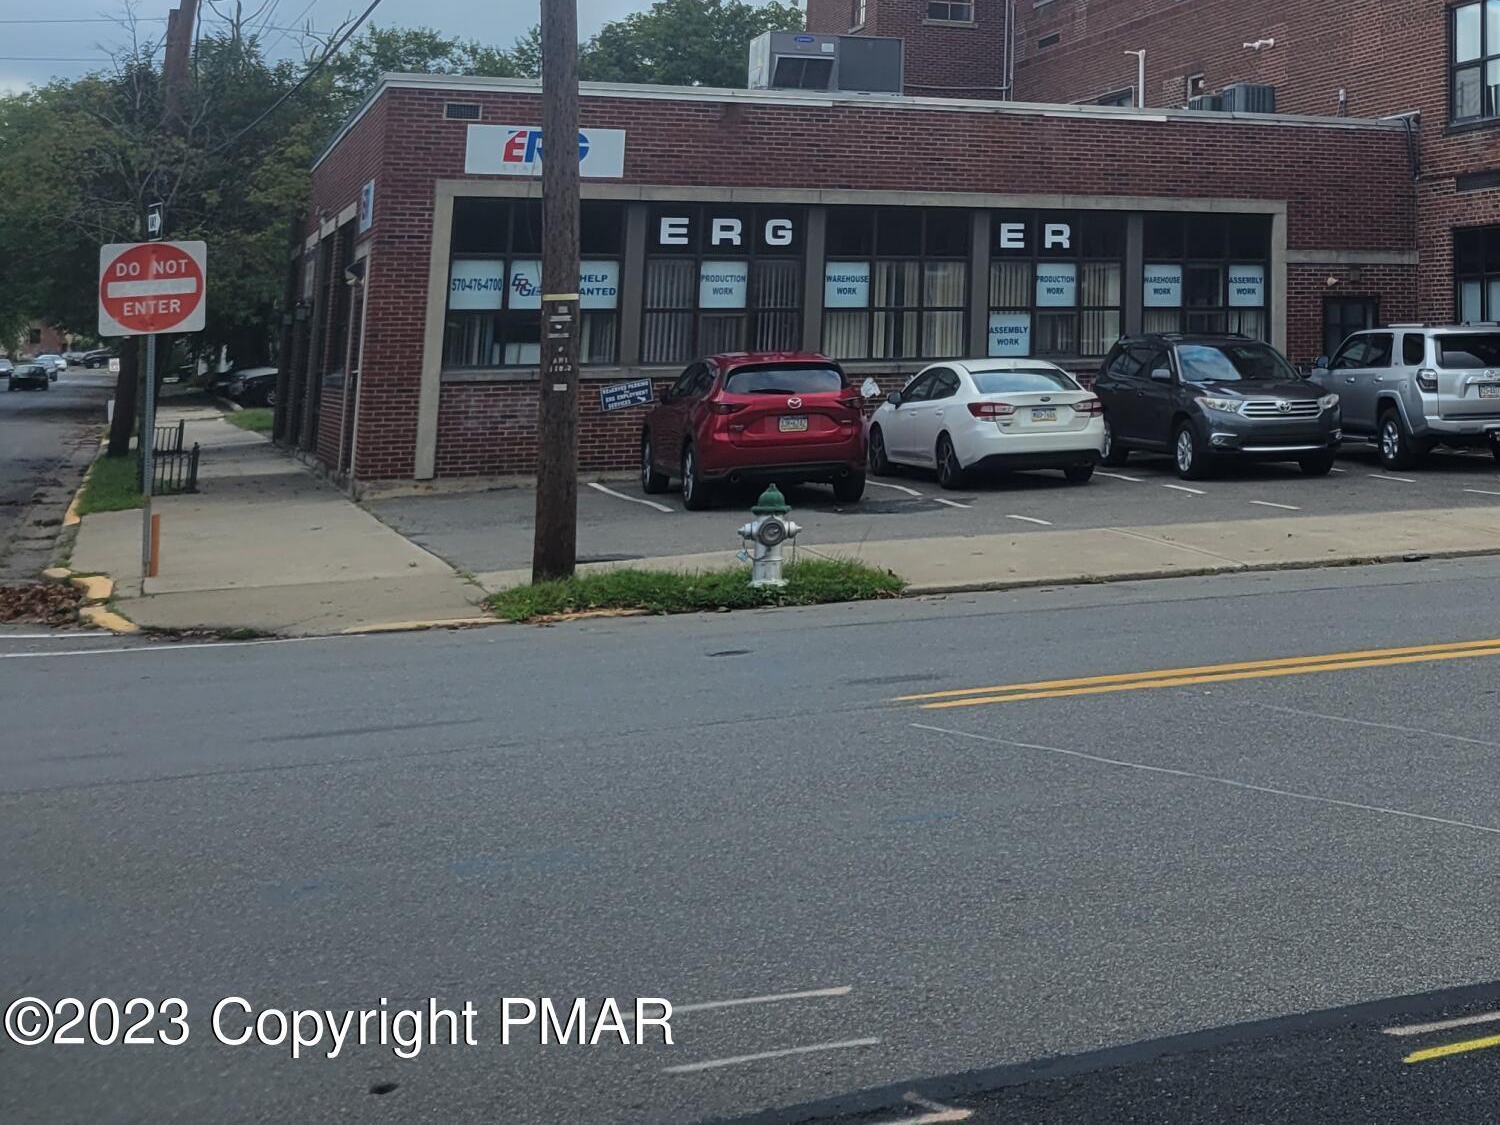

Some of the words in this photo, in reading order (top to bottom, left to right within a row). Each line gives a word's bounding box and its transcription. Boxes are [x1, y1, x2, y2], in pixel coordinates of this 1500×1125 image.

[116, 262, 140, 277] DO
[152, 259, 188, 275] NOT
[580, 275, 608, 283] HELP
[701, 275, 746, 283] PRODUCTION
[825, 275, 870, 283] WAREHOUSE
[1036, 275, 1075, 284] PRODUCTION
[1144, 276, 1181, 284] WAREHOUSE
[1229, 276, 1263, 284] ASSEMBLY
[452, 278, 502, 292] 570-476-4700
[580, 287, 616, 296] ANTED
[712, 287, 734, 295] WORK
[836, 287, 857, 295] WORK
[1046, 287, 1064, 295] WORK
[1153, 287, 1171, 295] WORK
[1236, 287, 1256, 295] WORK
[124, 299, 180, 316] ENTER
[989, 326, 1028, 334] ASSEMBLY
[996, 338, 1020, 346] WORK
